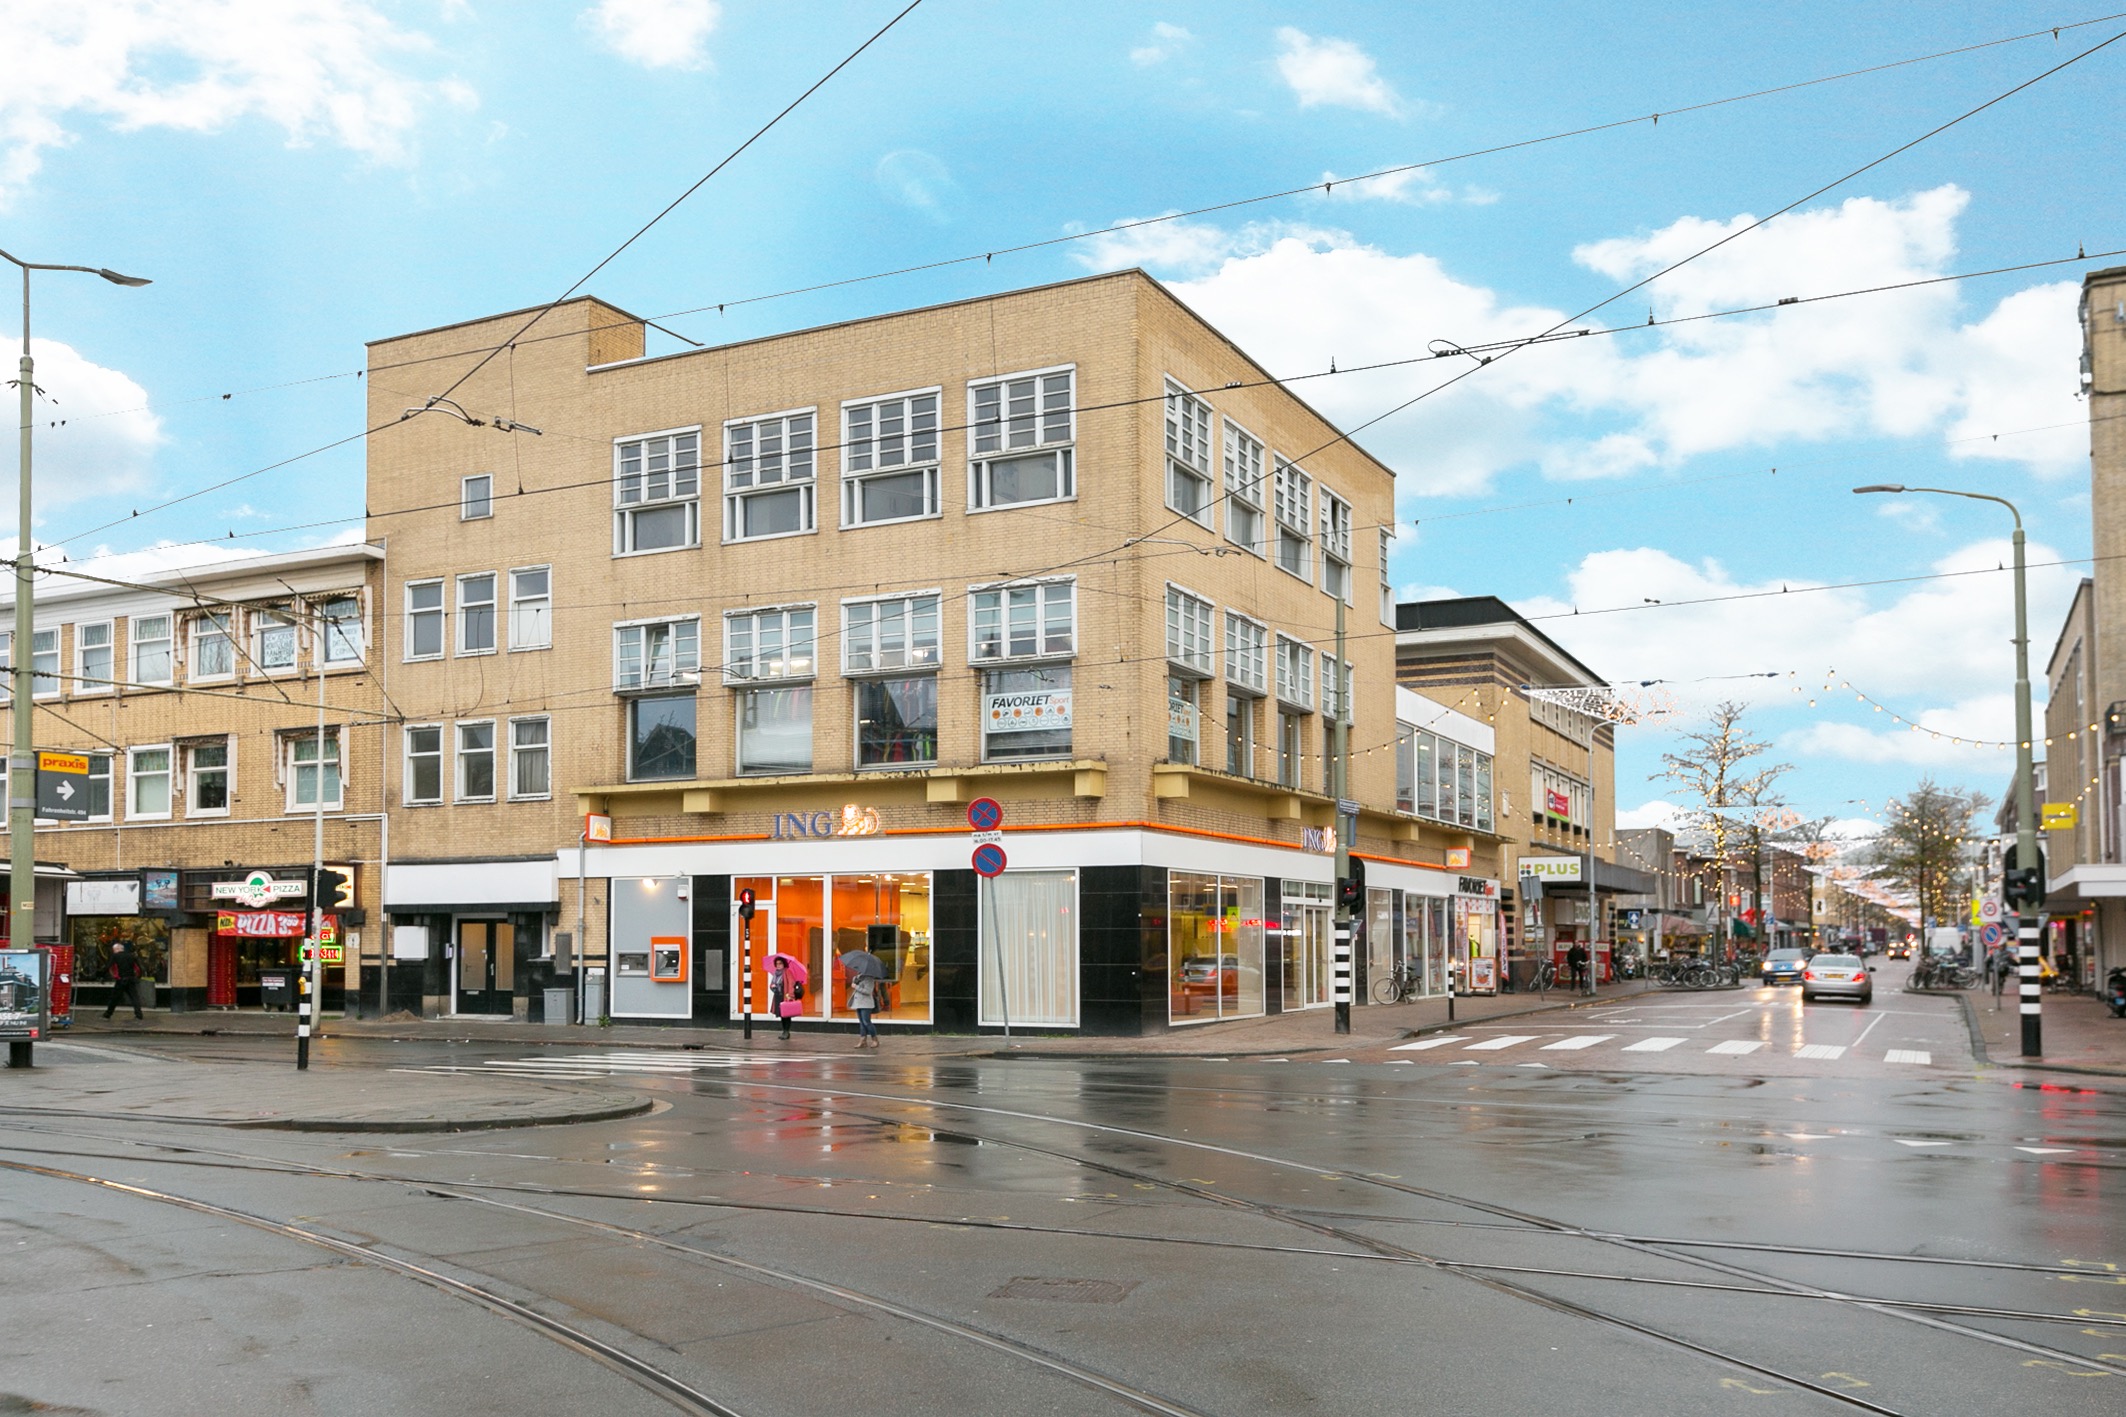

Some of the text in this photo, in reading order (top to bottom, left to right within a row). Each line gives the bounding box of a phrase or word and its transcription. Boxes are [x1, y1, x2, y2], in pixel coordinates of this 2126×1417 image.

[992, 695, 1069, 709] FAVORIET Sport
[43, 758, 87, 770] praxis
[773, 811, 833, 839] ING
[1302, 827, 1325, 852] ING
[1534, 863, 1579, 875] PLUS
[215, 885, 301, 894] NEW YORK PIZZA
[237, 913, 276, 935] PIZZA
